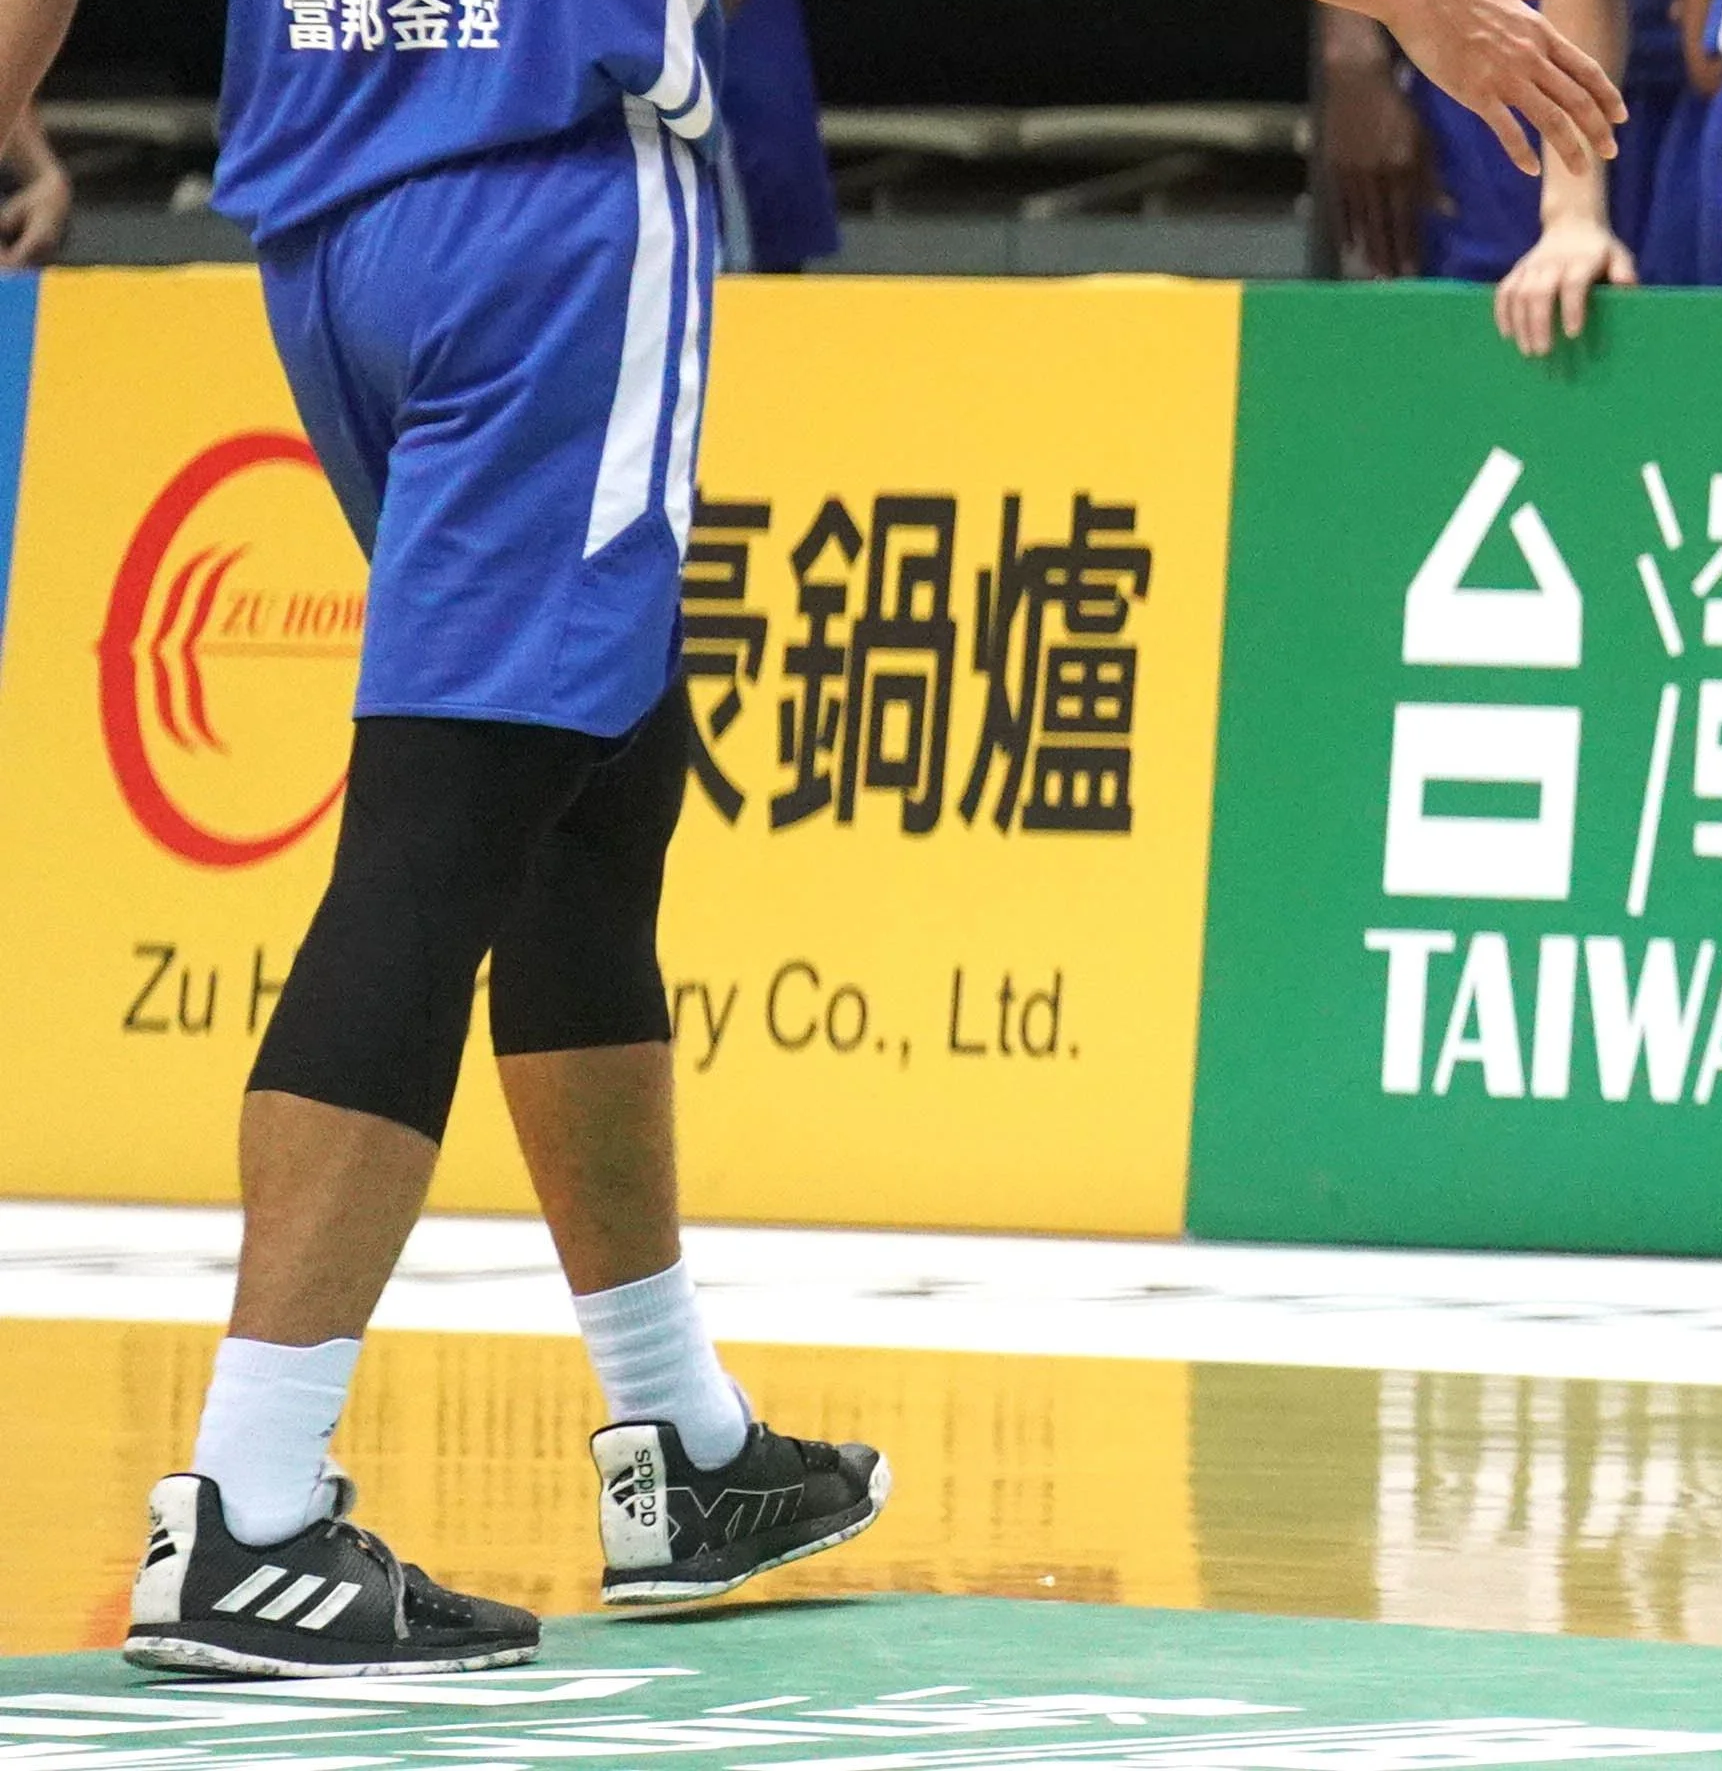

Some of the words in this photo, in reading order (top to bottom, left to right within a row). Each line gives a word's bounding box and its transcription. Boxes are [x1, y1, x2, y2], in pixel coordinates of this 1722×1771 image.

[121, 941, 220, 1037] Zu
[764, 958, 913, 1072] Co.,
[946, 966, 1083, 1061] Ltd.
